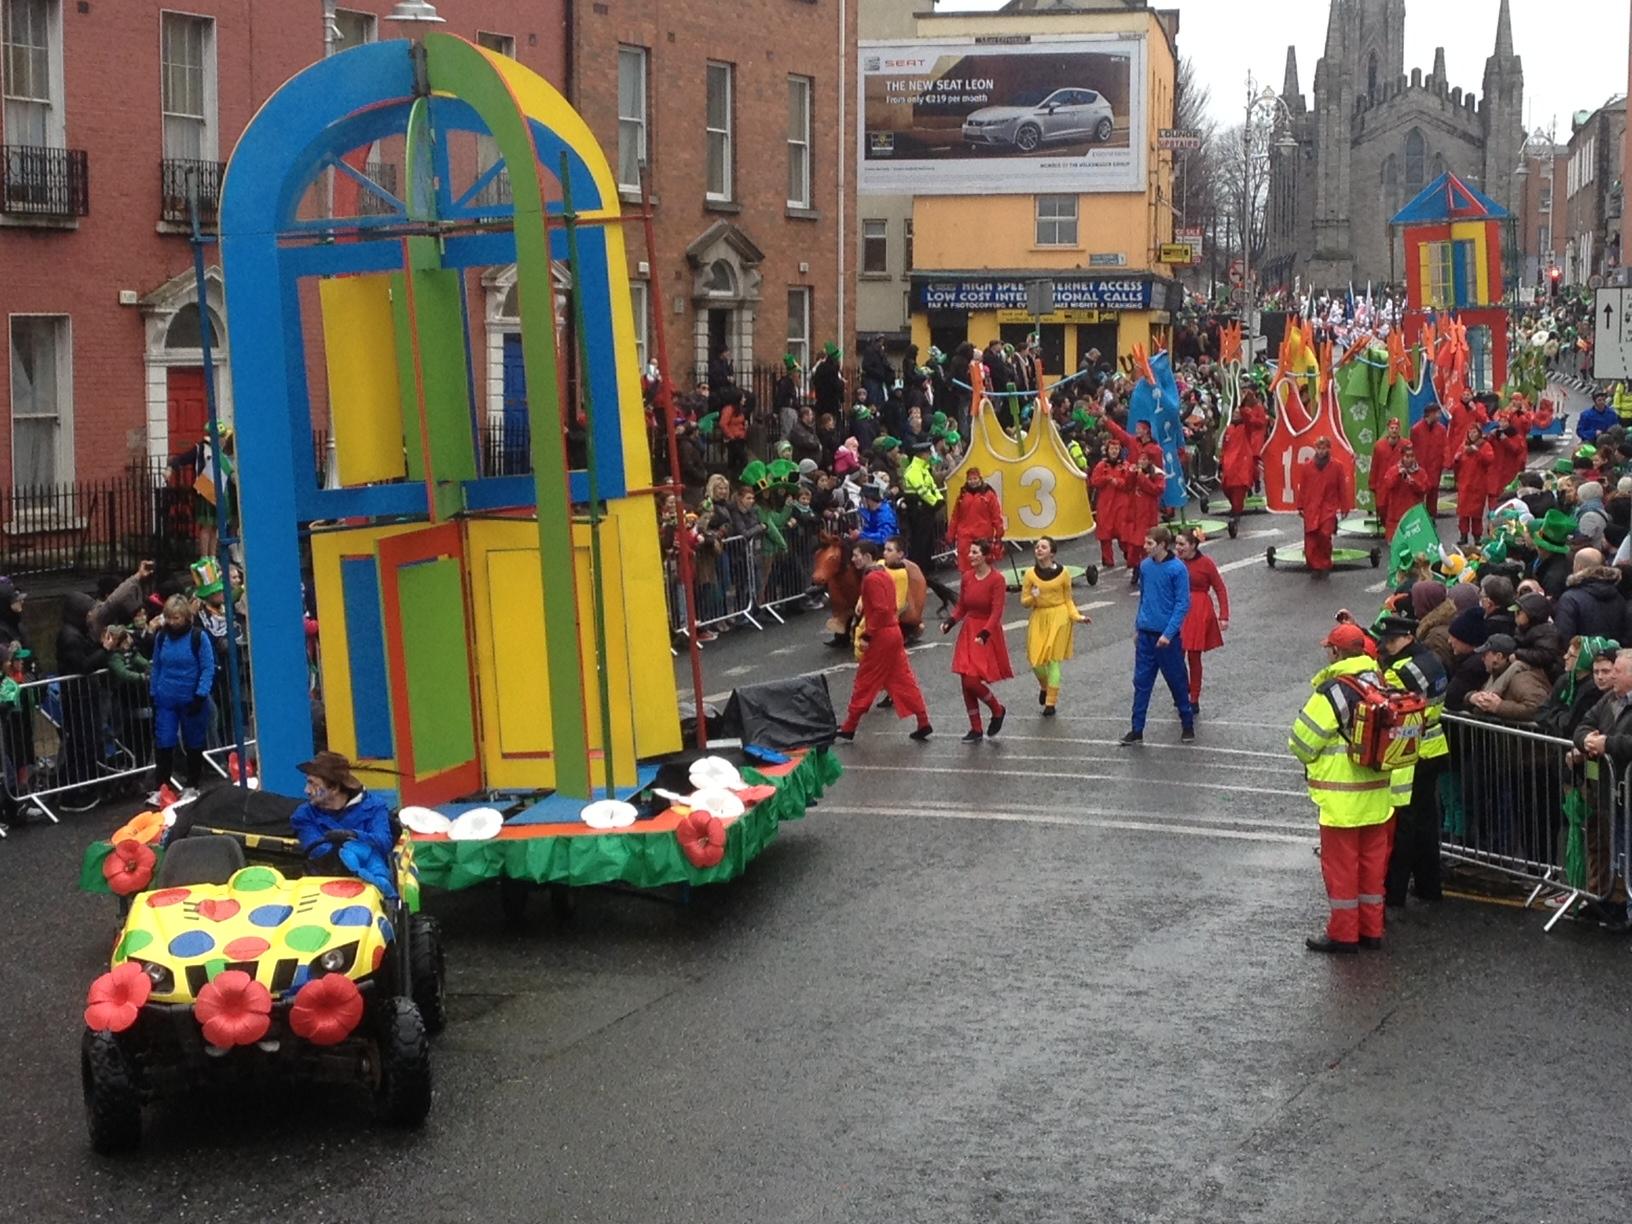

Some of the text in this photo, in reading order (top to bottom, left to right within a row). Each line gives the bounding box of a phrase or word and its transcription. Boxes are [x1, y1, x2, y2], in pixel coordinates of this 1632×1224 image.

[885, 59, 925, 67] SEAT
[886, 79, 994, 91] THE NEW SEAT LEON
[886, 95, 905, 104] From
[907, 95, 924, 105] only
[948, 96, 960, 104] per
[961, 94, 988, 103] month
[962, 282, 993, 291] HIGH
[997, 282, 1025, 291] SPEE
[1052, 281, 1094, 291] TERNET
[1098, 281, 1142, 291] ACCESS
[927, 291, 956, 301] LOW
[959, 291, 992, 301] COST
[1103, 291, 1142, 301] CALLS
